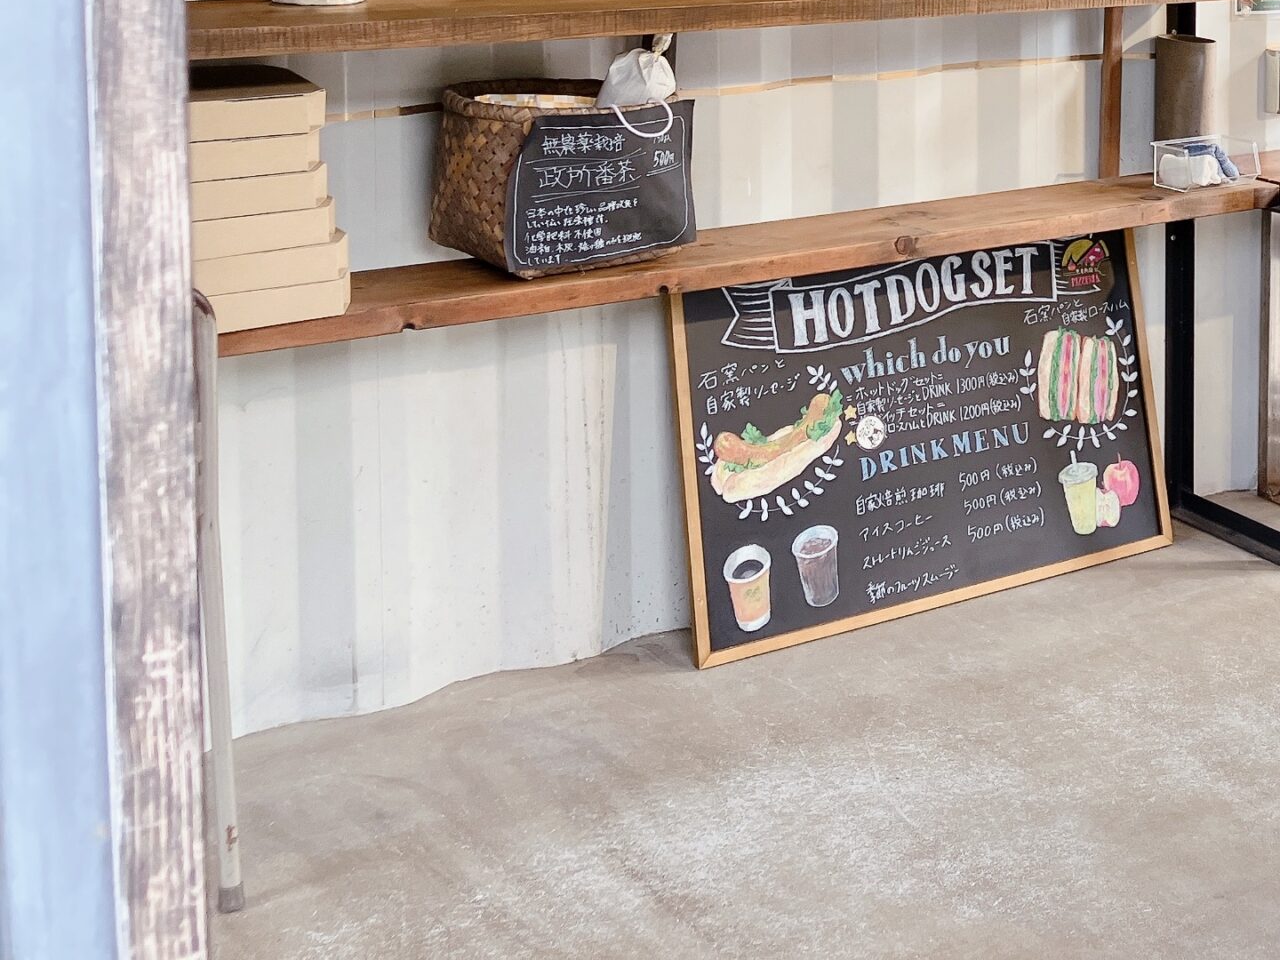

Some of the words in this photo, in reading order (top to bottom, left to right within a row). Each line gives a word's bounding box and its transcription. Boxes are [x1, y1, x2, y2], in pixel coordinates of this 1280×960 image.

[840, 338, 927, 385] which
[961, 334, 1011, 369] you
[858, 436, 950, 481] DRINK
[951, 420, 1029, 458] MENU
[858, 514, 933, 542] アイスコーヒー
